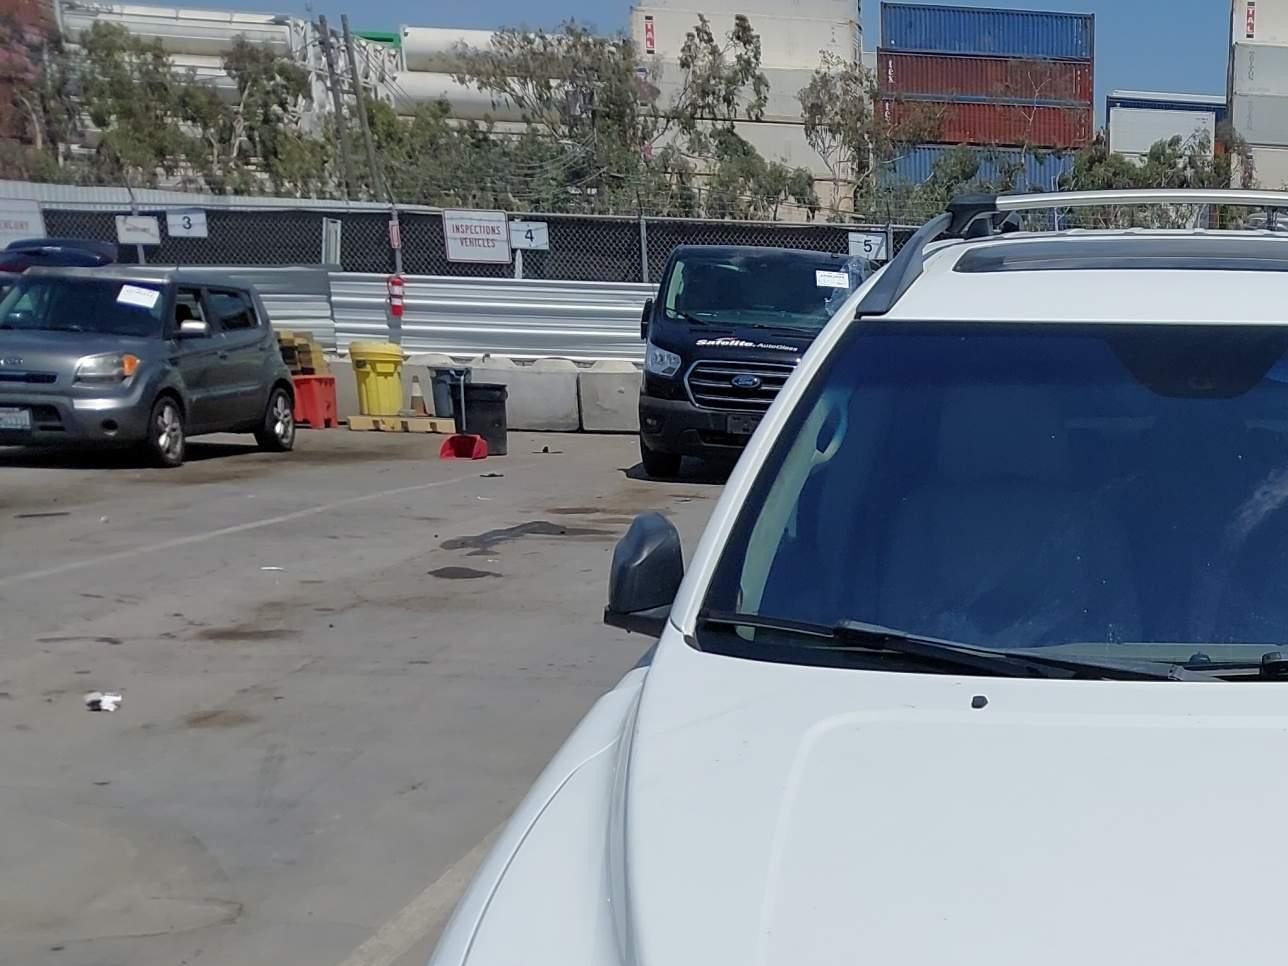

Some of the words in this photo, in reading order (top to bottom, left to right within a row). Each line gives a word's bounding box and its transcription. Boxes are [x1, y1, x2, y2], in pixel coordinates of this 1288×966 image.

[1246, 8, 1255, 33] TAL
[645, 22, 655, 48] TAL
[182, 216, 192, 229] 3
[452, 224, 500, 235] INSPECTIONS
[525, 229, 534, 242] 4
[460, 238, 496, 248] VEHICLES
[863, 240, 872, 252] 5
